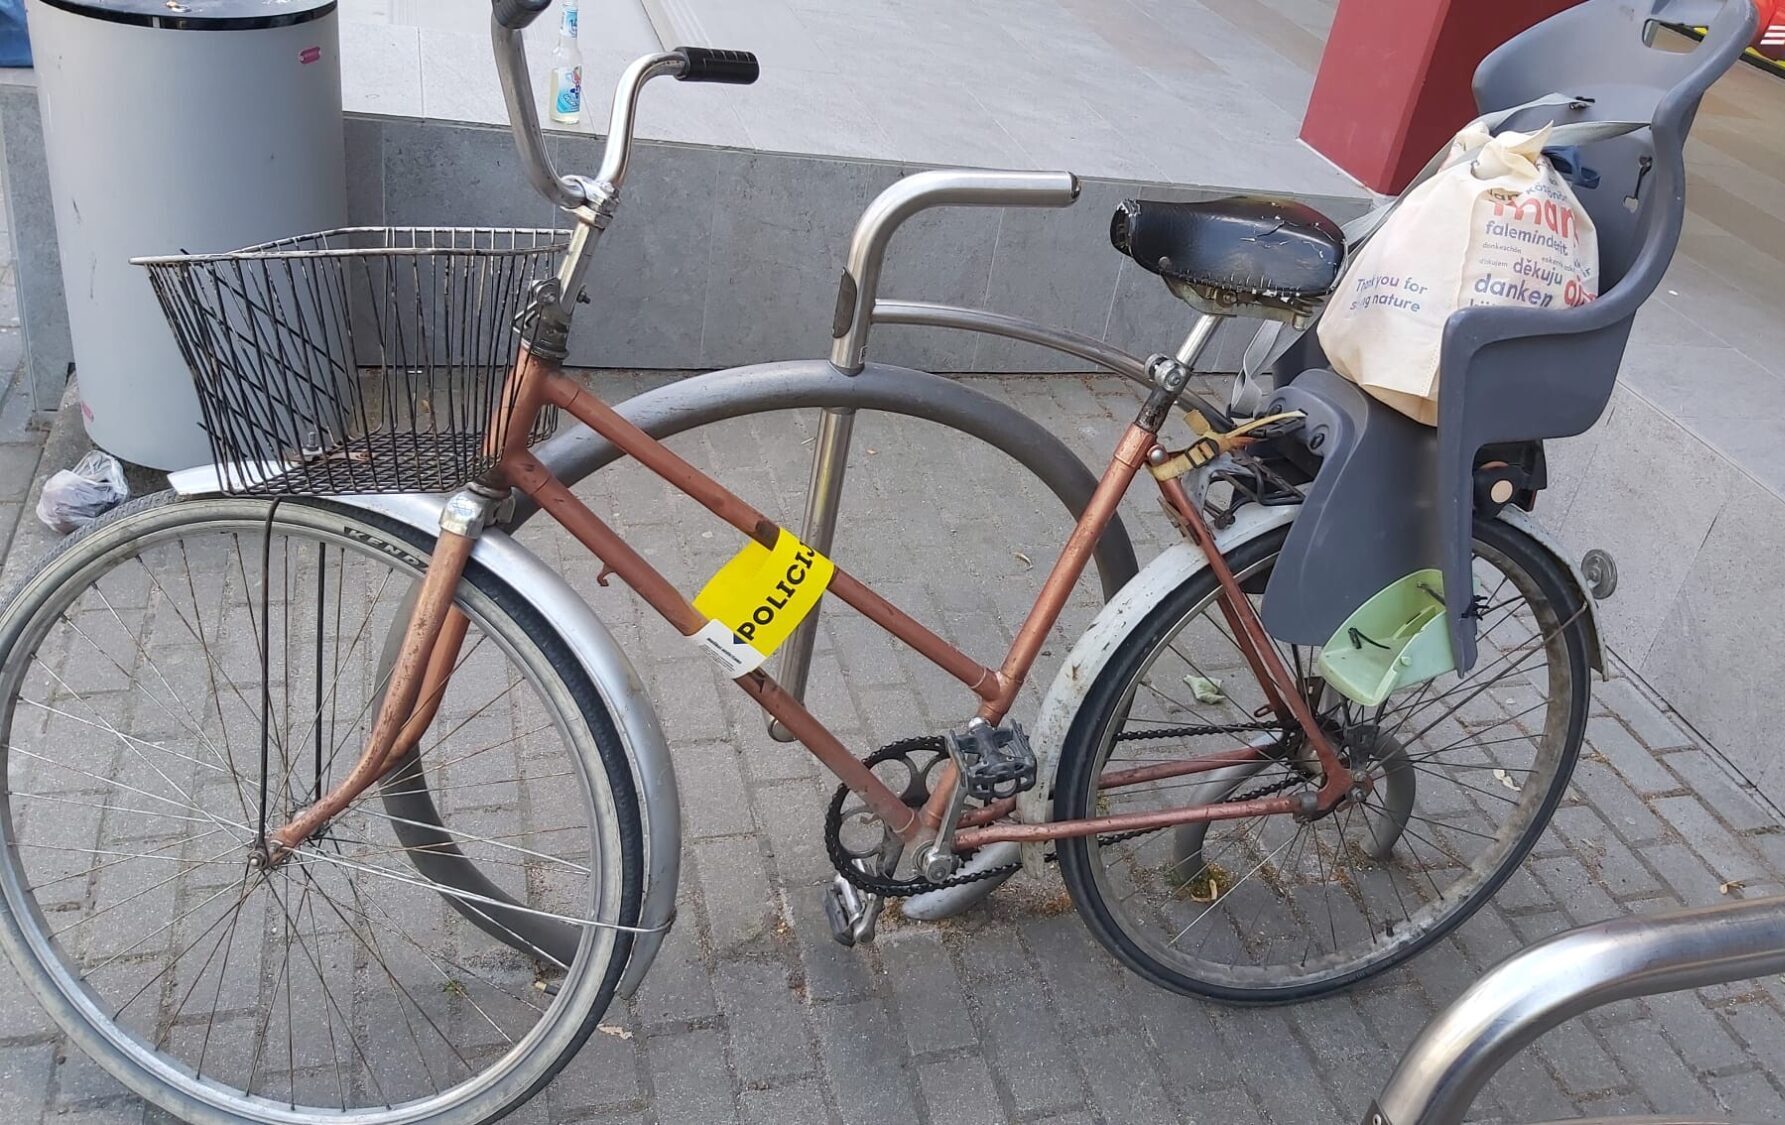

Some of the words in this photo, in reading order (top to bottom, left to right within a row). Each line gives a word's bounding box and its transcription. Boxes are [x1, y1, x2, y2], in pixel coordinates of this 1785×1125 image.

[1375, 275, 1400, 289] you
[1403, 277, 1428, 294] for
[1513, 257, 1563, 286] děkuju
[1372, 293, 1421, 312] nature
[1474, 273, 1553, 308] danken
[347, 529, 429, 573] KEND
